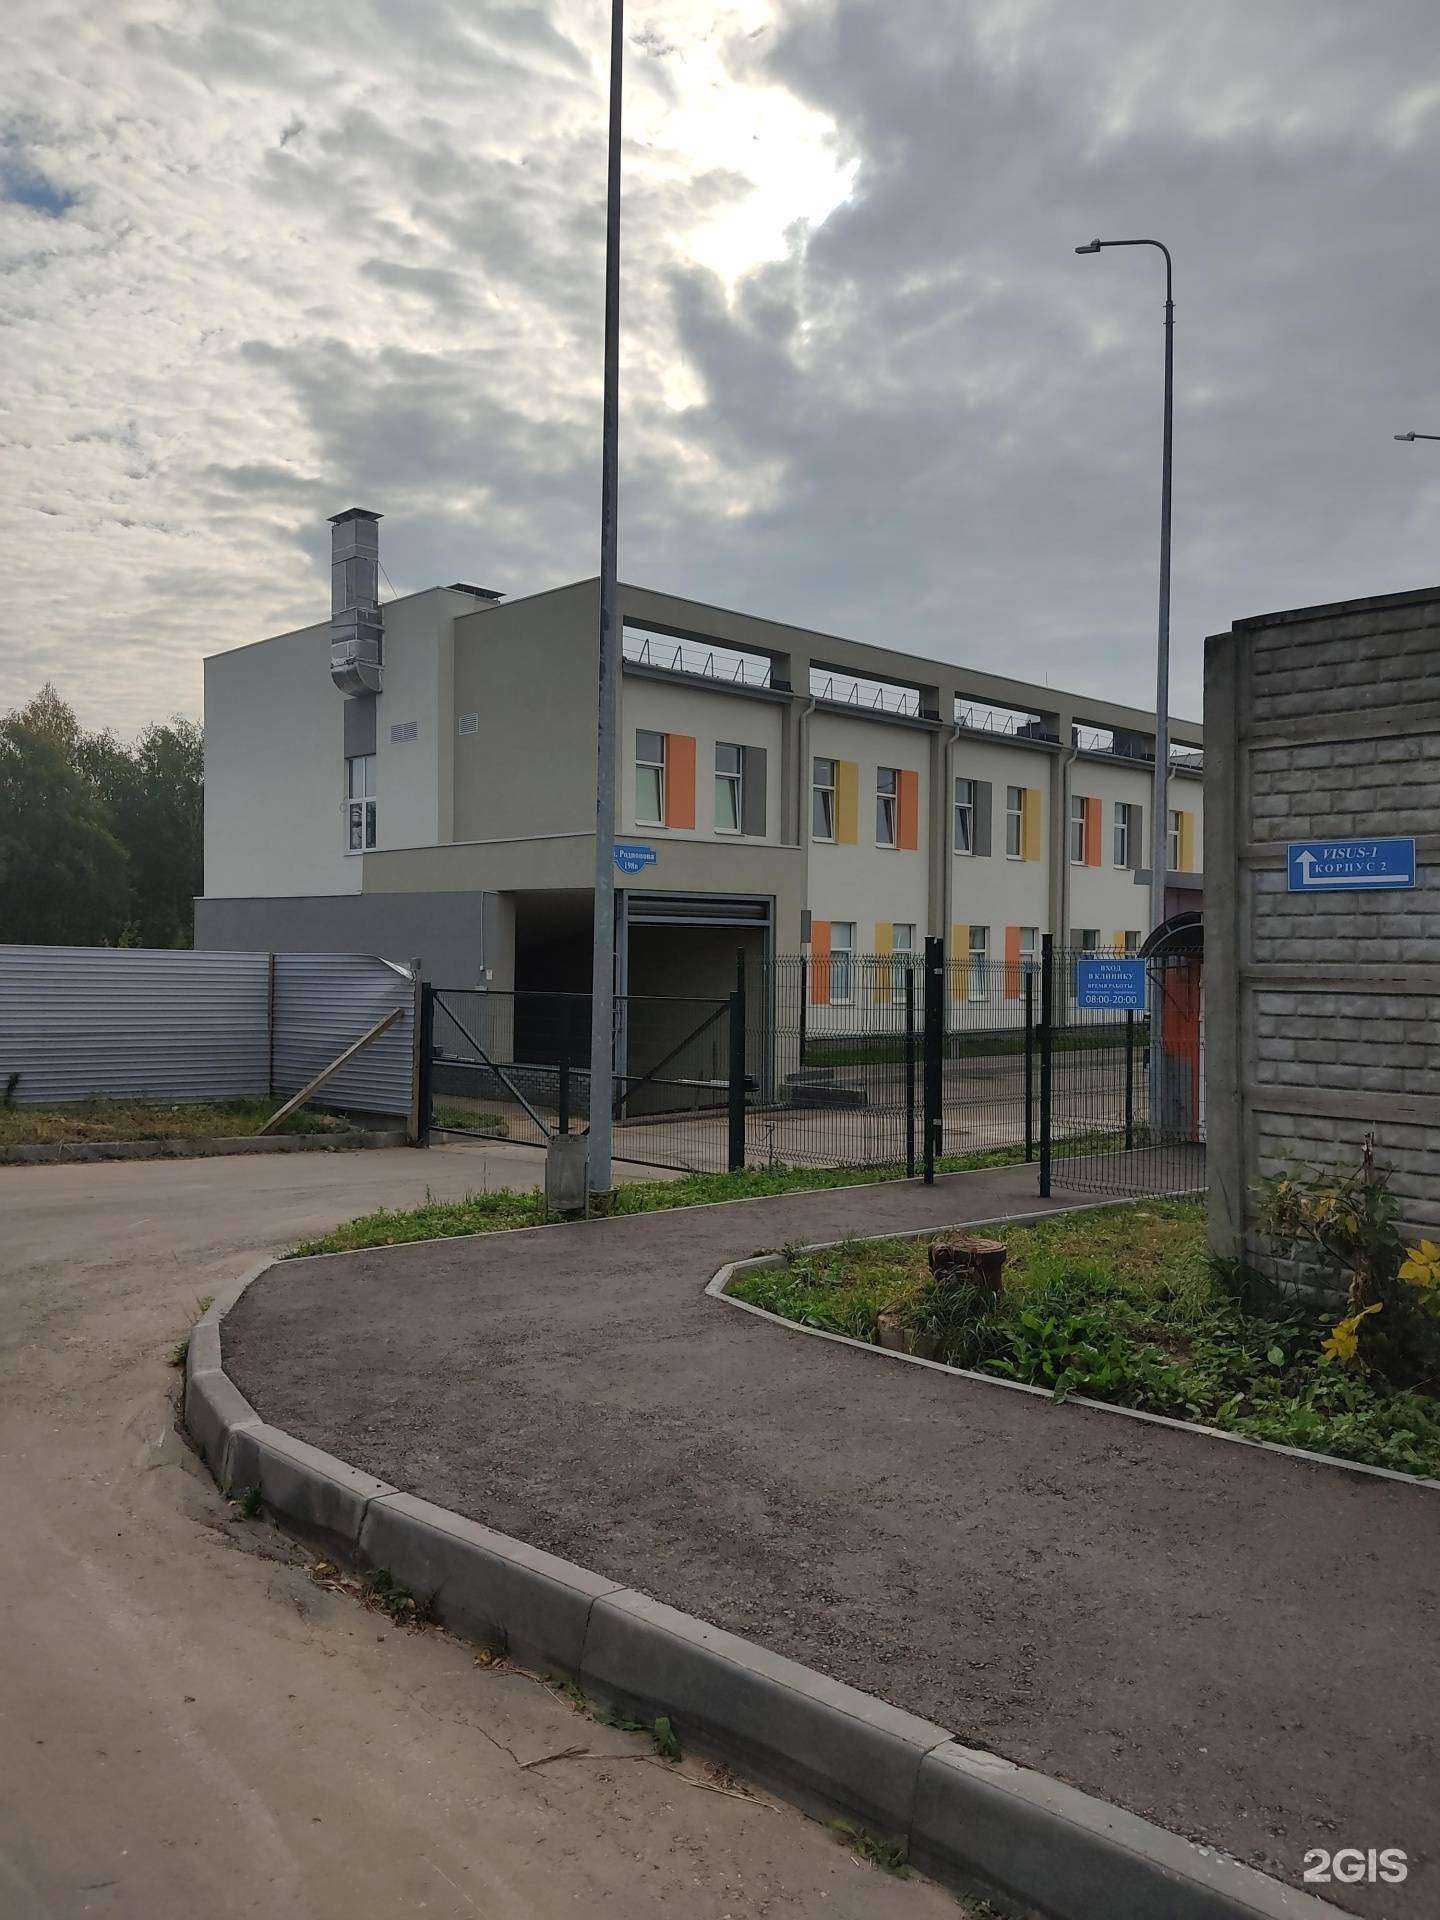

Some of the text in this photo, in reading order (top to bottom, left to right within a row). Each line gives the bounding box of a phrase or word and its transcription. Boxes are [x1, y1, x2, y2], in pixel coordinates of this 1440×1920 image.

[1323, 846, 1377, 859] VISUS-1
[1316, 861, 1387, 873] КОРПУС 2
[1085, 994, 1137, 1004] 08:00-20:00
